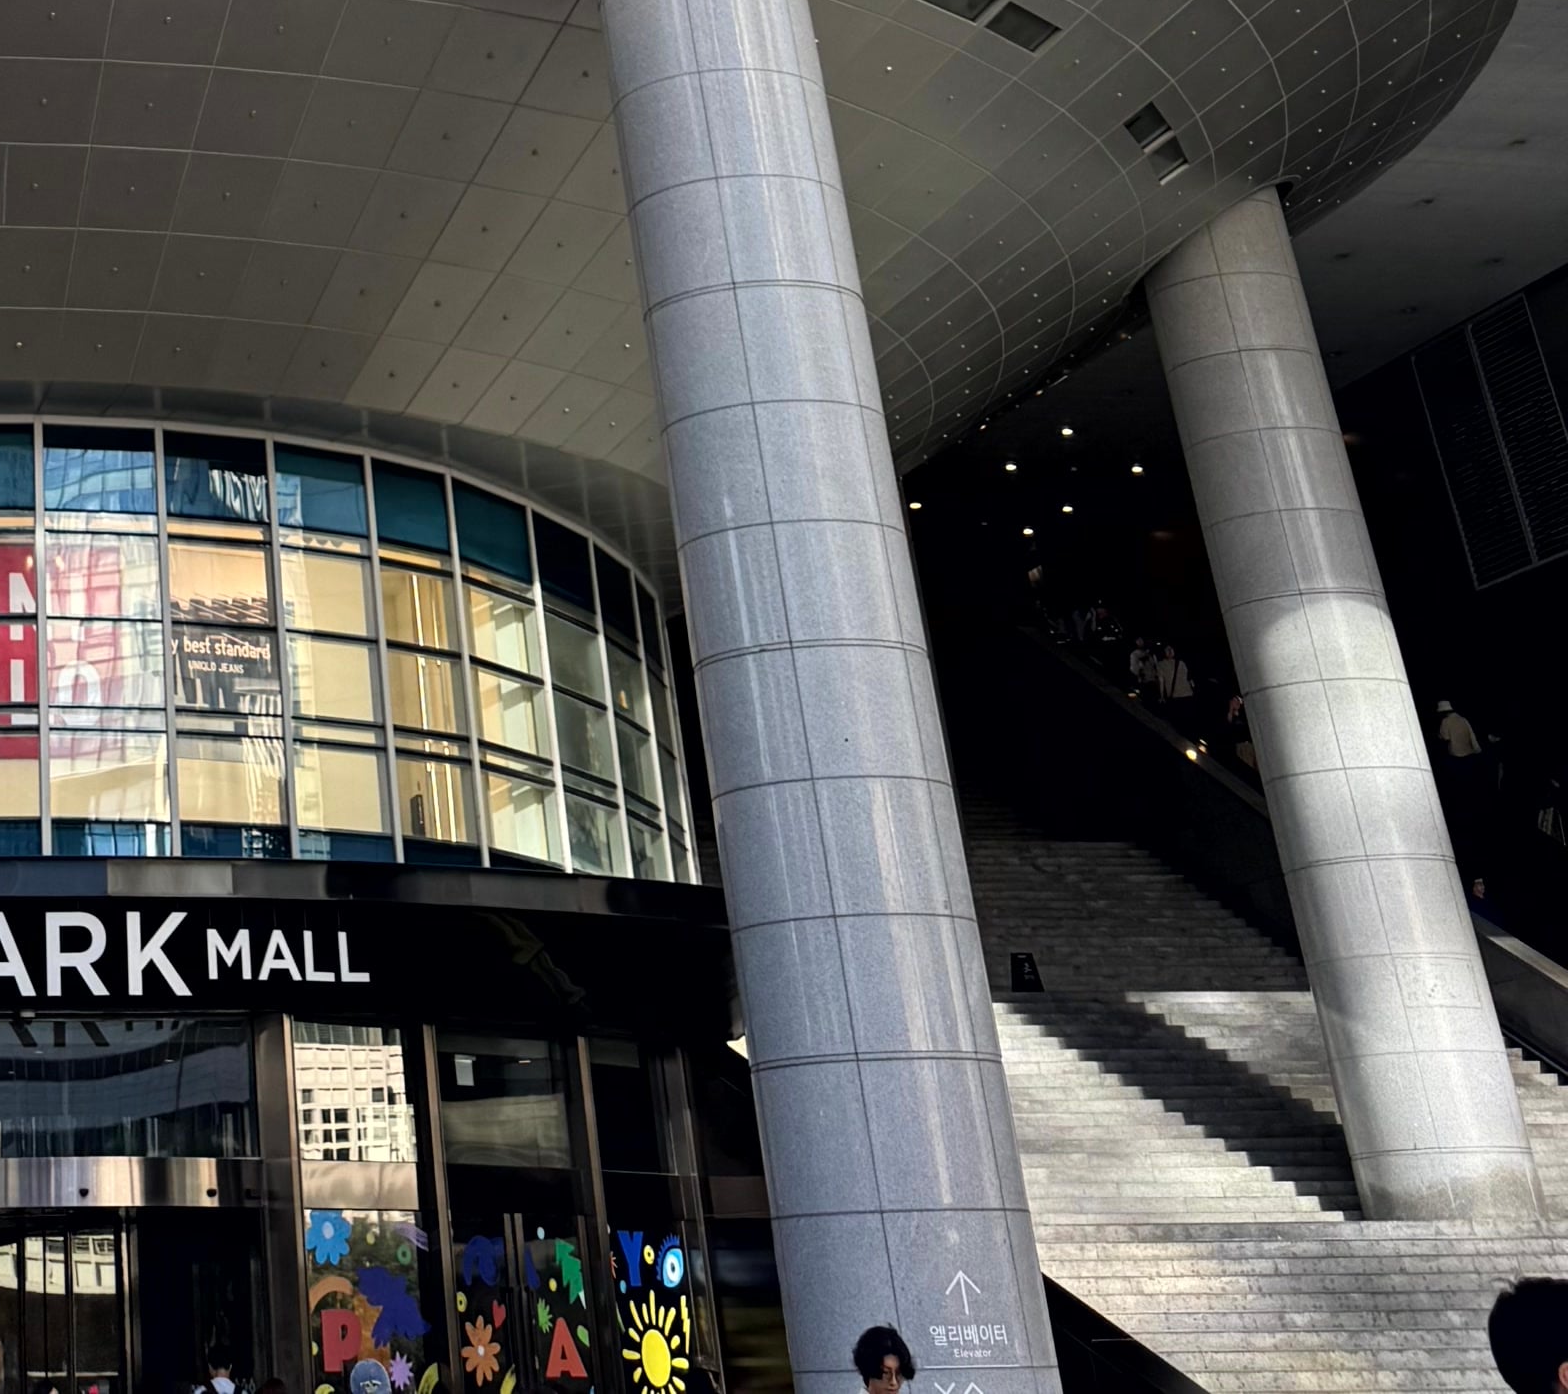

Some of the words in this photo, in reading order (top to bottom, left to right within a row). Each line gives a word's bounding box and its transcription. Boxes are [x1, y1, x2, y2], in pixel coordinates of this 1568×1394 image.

[183, 635, 211, 654] best
[214, 638, 271, 660] standard
[218, 662, 245, 674] JEANS
[207, 928, 371, 984] MALL
[929, 1323, 1008, 1346] 엘리베이터
[953, 1348, 991, 1358] Elevator
